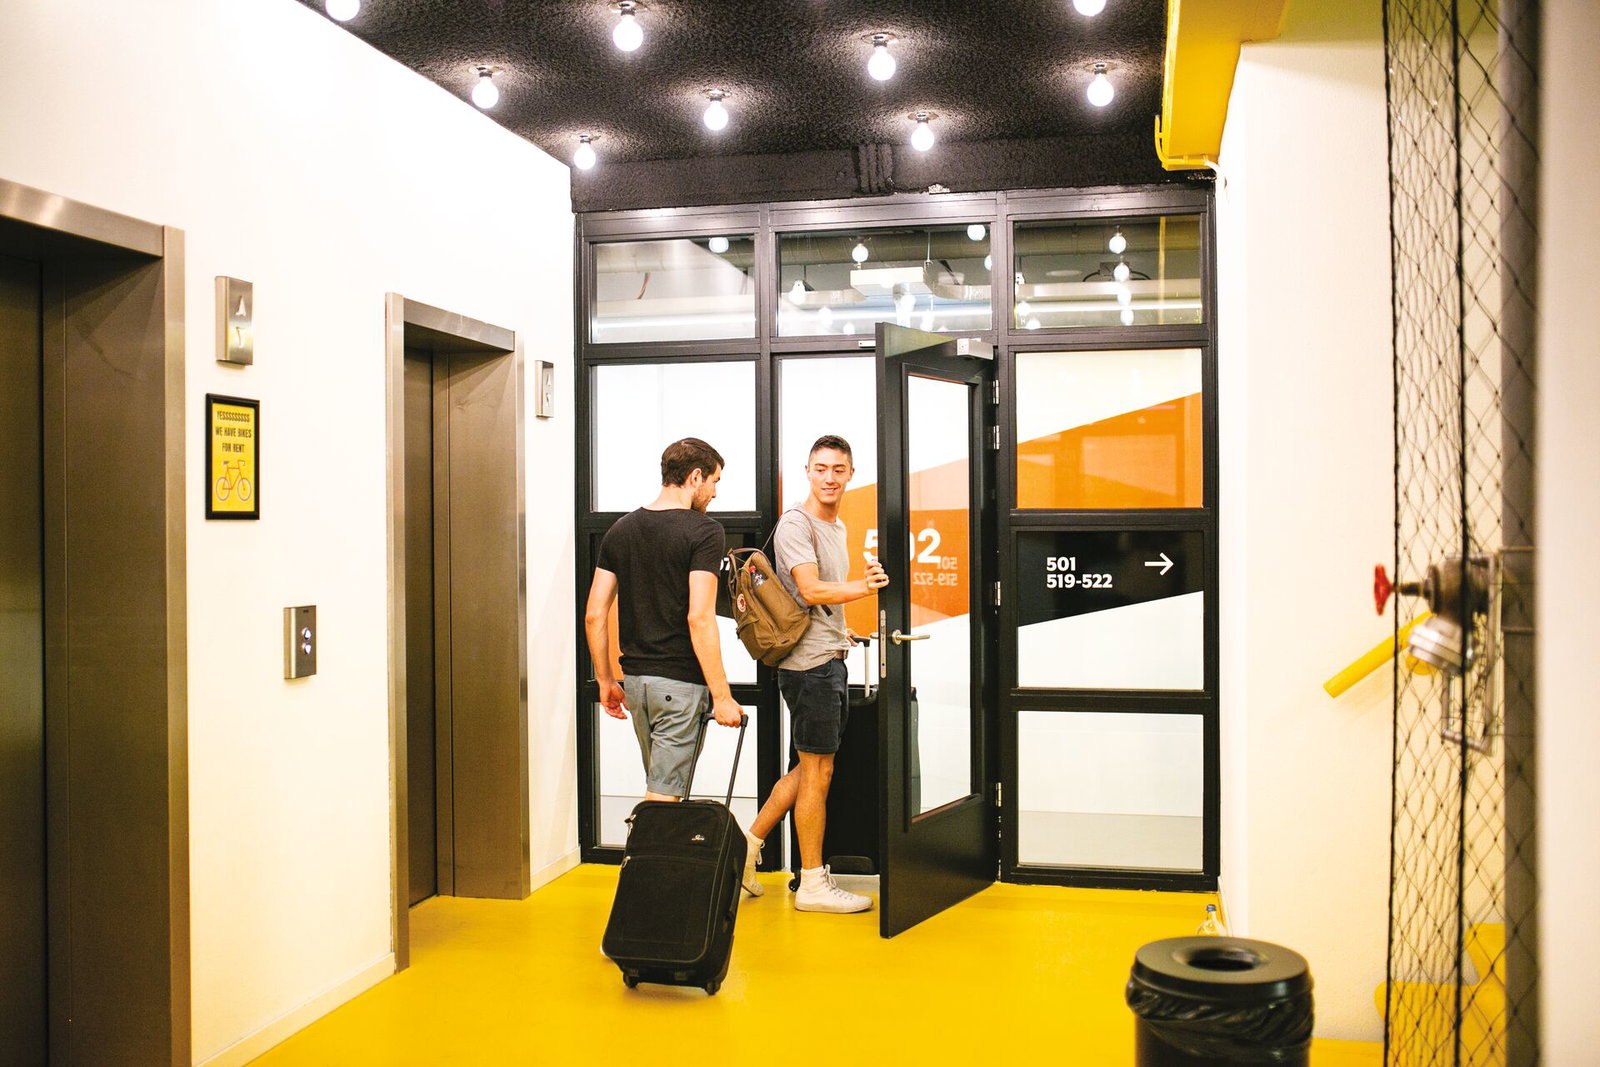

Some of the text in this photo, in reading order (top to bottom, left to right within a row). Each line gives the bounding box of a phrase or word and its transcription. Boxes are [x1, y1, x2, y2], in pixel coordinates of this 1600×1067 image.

[215, 426, 252, 438] WE HAVE BIKES
[222, 443, 245, 453] FOR RENT
[863, 528, 941, 564] 52
[1046, 556, 1076, 572] 501
[1046, 573, 1113, 588] 519-522
